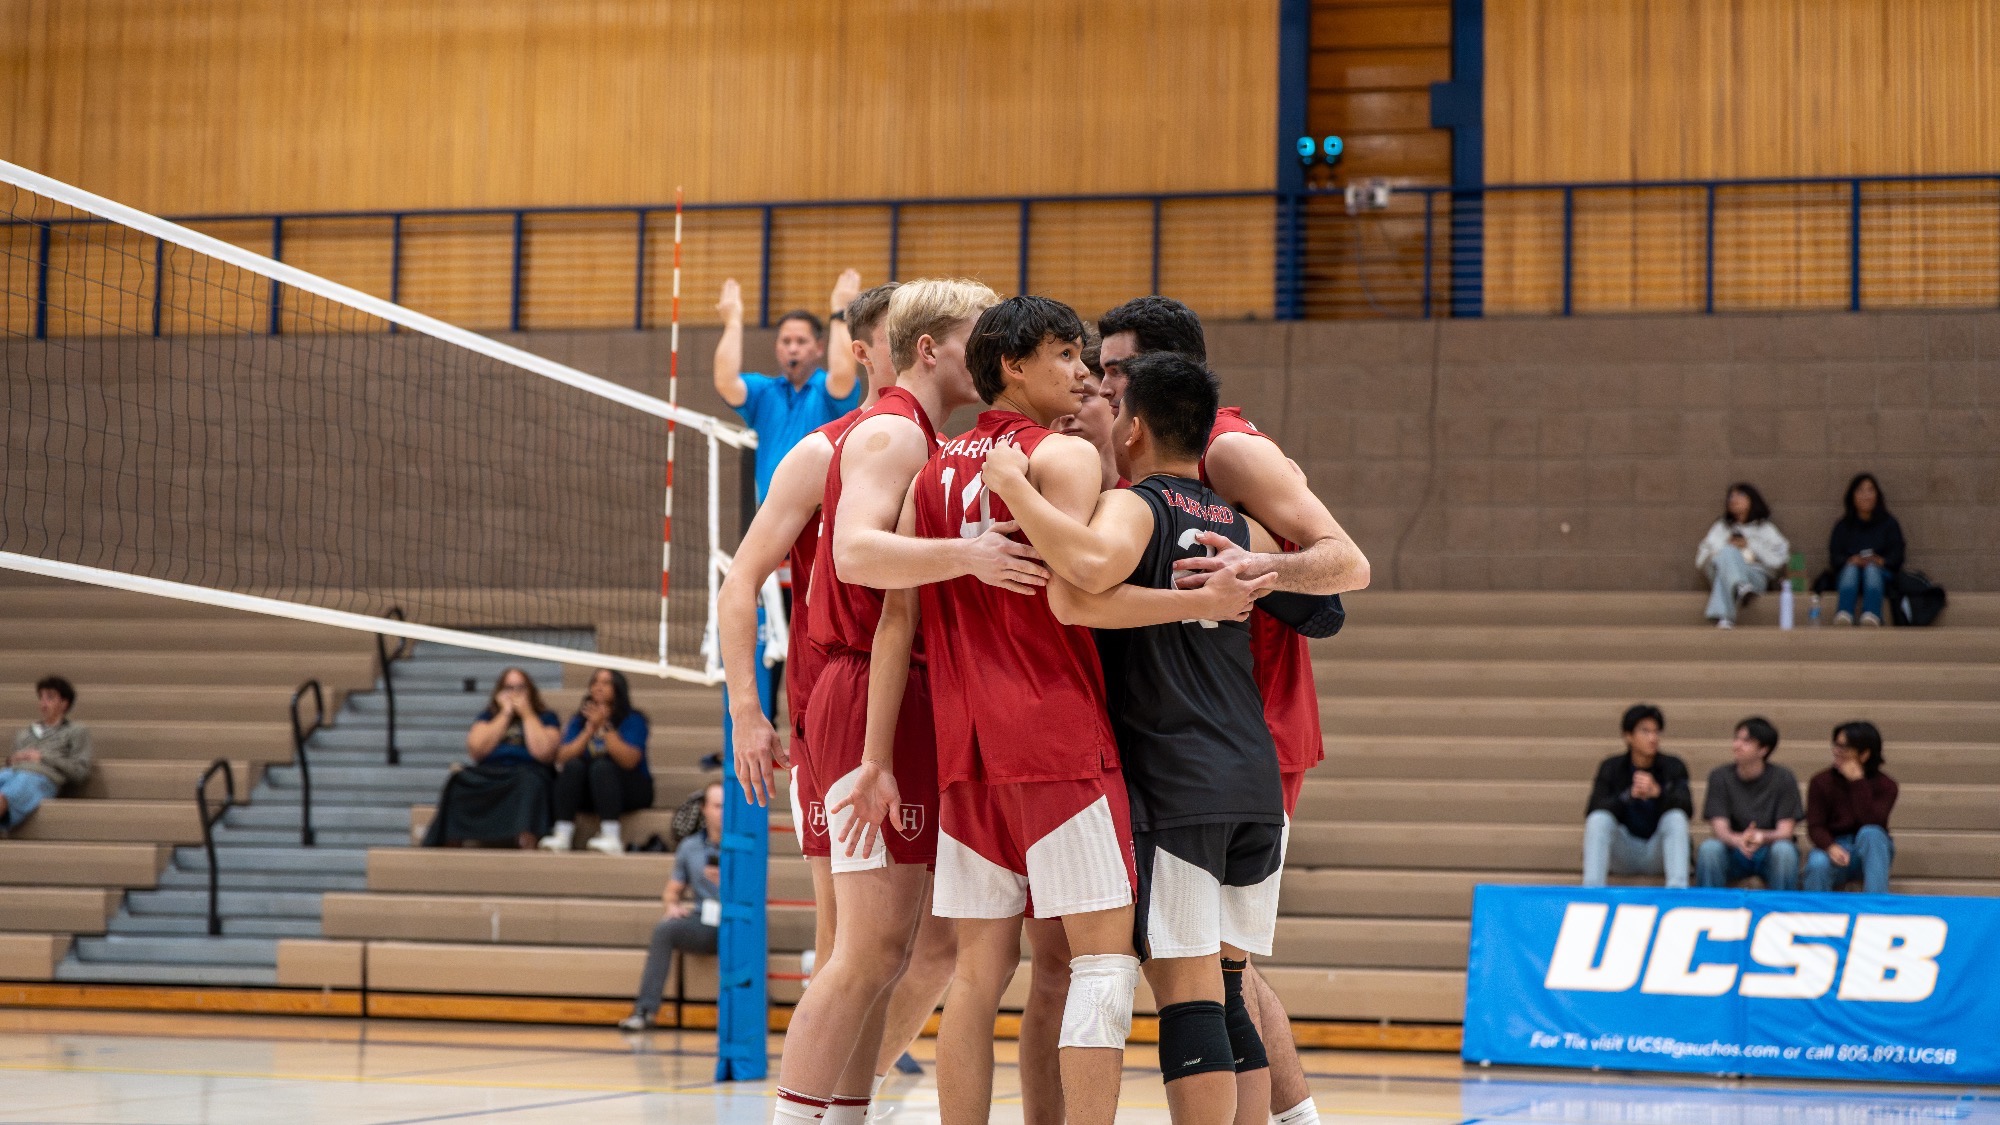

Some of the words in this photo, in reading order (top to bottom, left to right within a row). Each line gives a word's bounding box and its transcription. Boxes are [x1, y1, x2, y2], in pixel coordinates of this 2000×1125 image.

[940, 430, 1016, 460] HARA
[1161, 488, 1234, 524] HARRD
[812, 806, 827, 826] H
[902, 808, 918, 830] H
[1544, 902, 1949, 1002] UCSB
[1530, 1031, 1560, 1049] For
[1563, 1033, 1588, 1050] Tix
[1591, 1034, 1624, 1051] visit
[1627, 1036, 1780, 1059] UCSBgauchos.com
[1783, 1047, 1801, 1059] or
[1805, 1044, 1835, 1060] call
[1837, 1044, 1957, 1065] 805.893.UCSB
